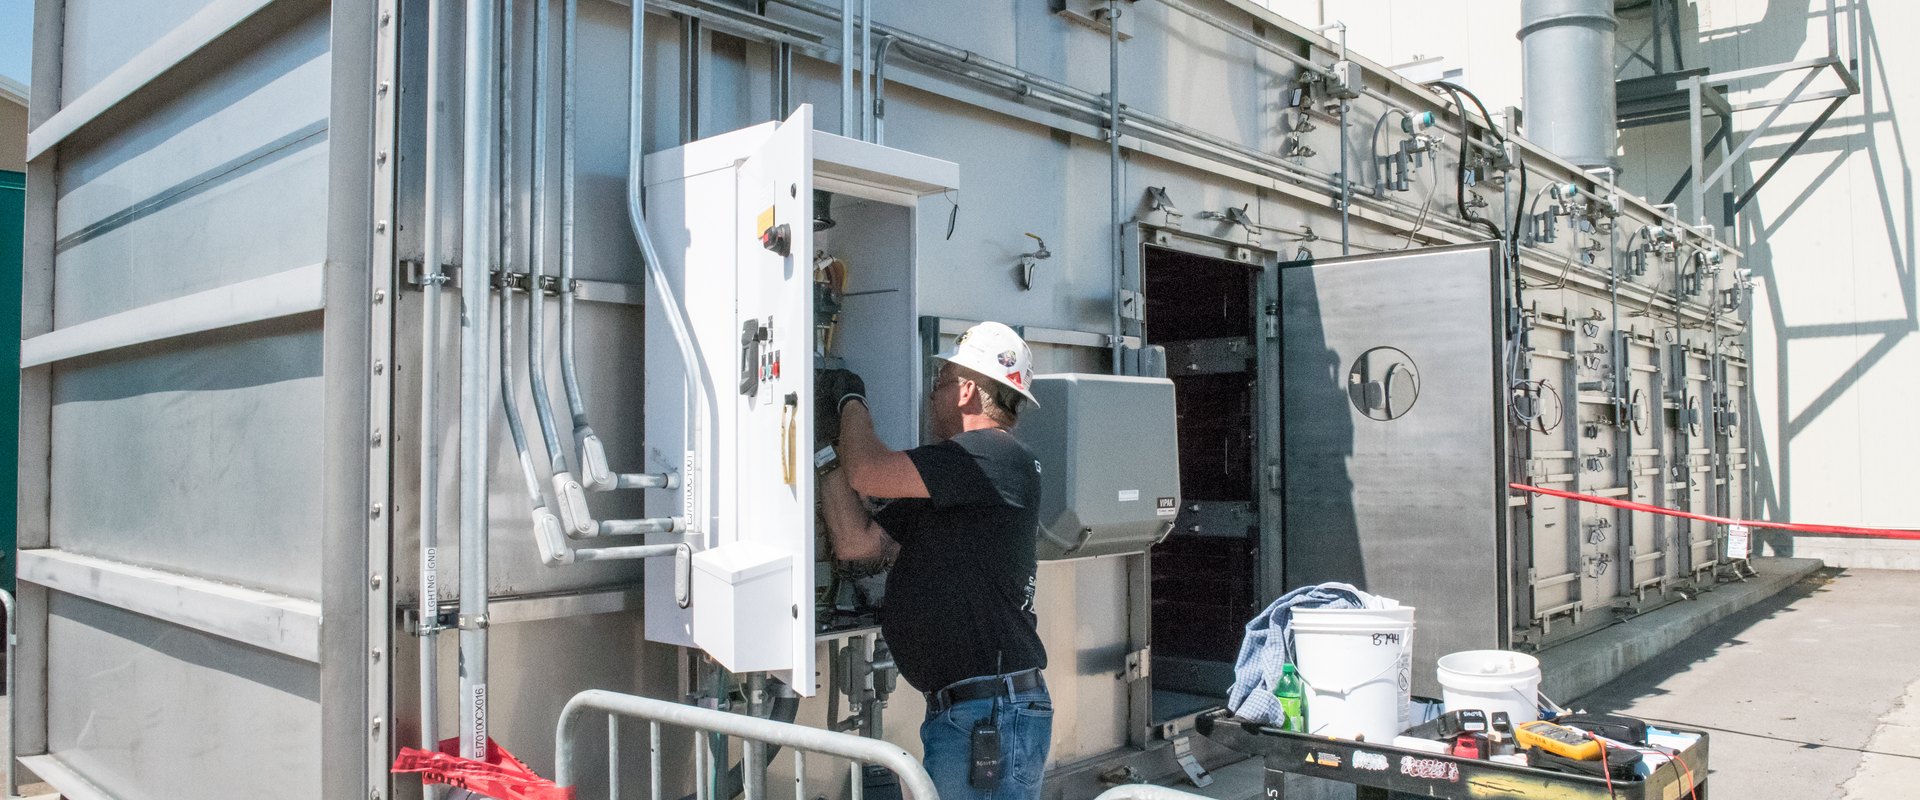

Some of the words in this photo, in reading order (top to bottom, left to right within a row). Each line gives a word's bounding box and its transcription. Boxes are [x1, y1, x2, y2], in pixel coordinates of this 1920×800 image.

[1159, 498, 1174, 508] VIPAK
[427, 548, 436, 569] GND
[427, 575, 436, 612] LGHTNG
[1371, 632, 1400, 646] B794
[474, 688, 485, 758] EJ70100CX016
